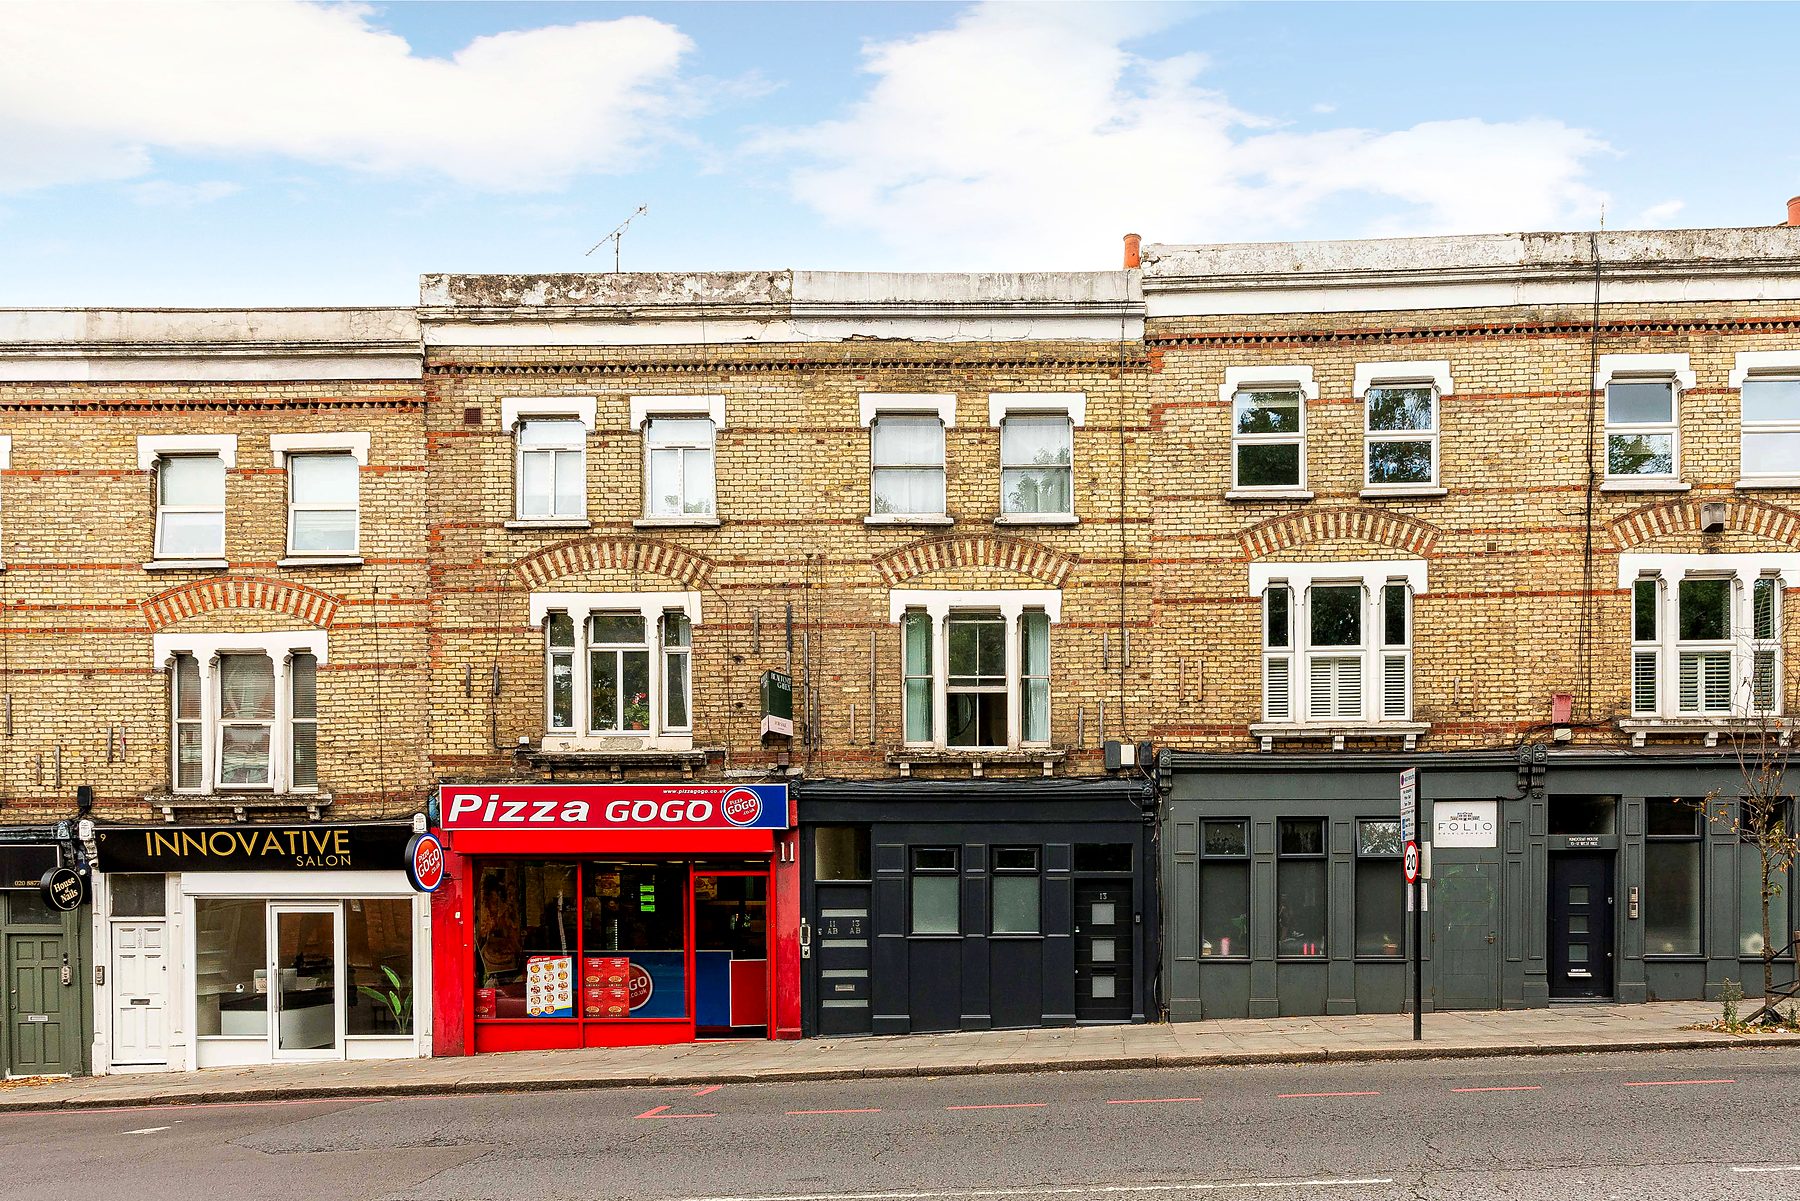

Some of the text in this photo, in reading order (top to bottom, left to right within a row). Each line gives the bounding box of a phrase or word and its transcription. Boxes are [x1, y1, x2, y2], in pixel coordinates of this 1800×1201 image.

[447, 794, 713, 822] Pizza GOGO
[727, 798, 756, 815] GOGO
[1438, 822, 1493, 831] FOLIO
[100, 833, 106, 842] 9
[146, 830, 349, 857] INNOVATIVE
[296, 854, 352, 867] SALON
[418, 849, 430, 863] Pizza
[780, 842, 795, 863] 11
[418, 848, 440, 878] GOGO
[1406, 854, 1416, 871] 20
[53, 876, 76, 893] House
[60, 889, 79, 903] Nails
[852, 919, 860, 927] 13
[628, 976, 648, 991] GO
